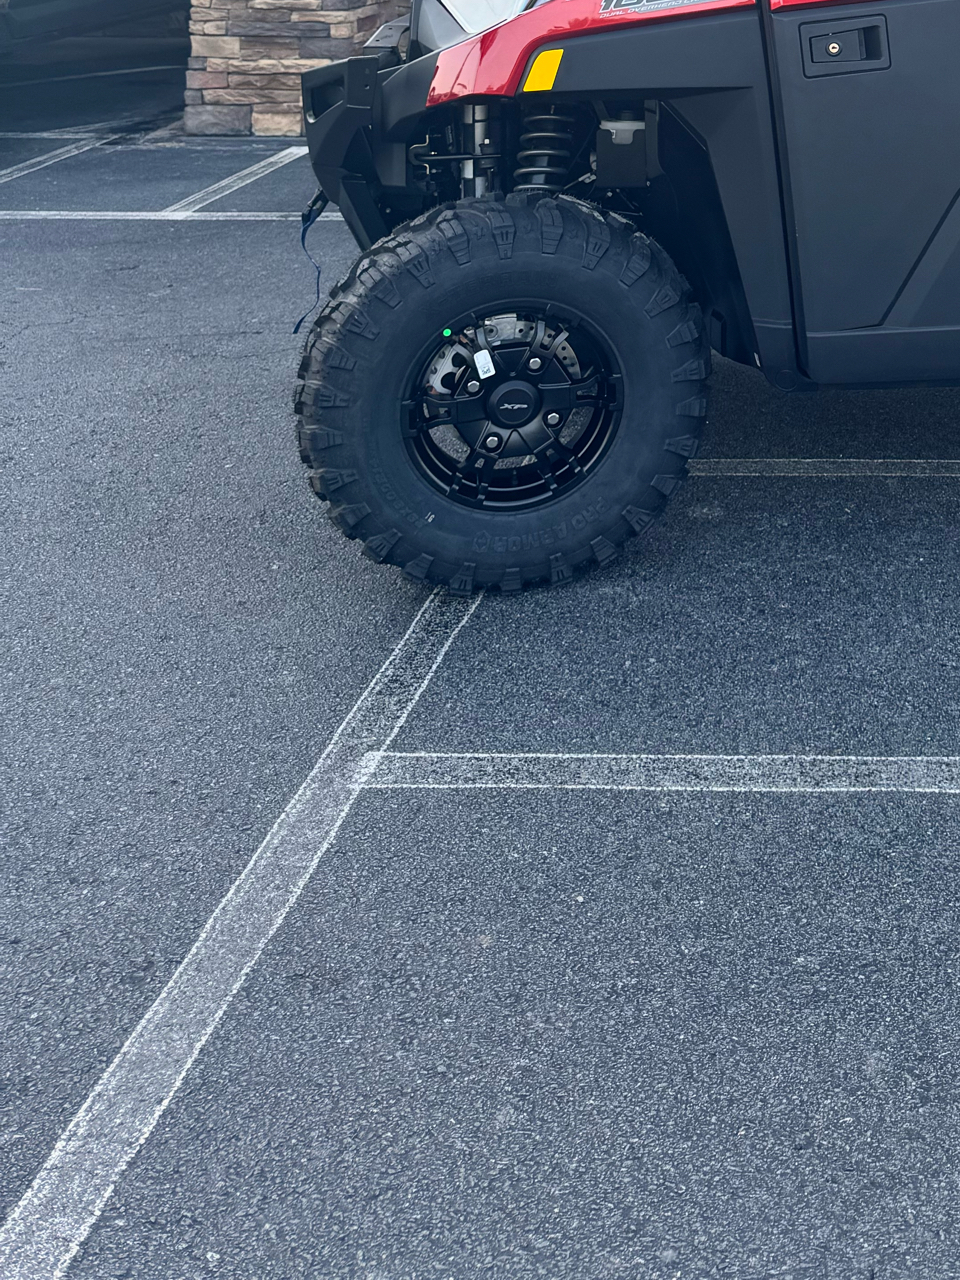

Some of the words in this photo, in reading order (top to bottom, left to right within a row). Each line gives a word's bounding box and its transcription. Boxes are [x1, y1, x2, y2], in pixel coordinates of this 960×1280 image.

[599, 10, 626, 19] DUAL
[628, 0, 683, 14] OVERHEAD
[499, 402, 529, 410] XP
